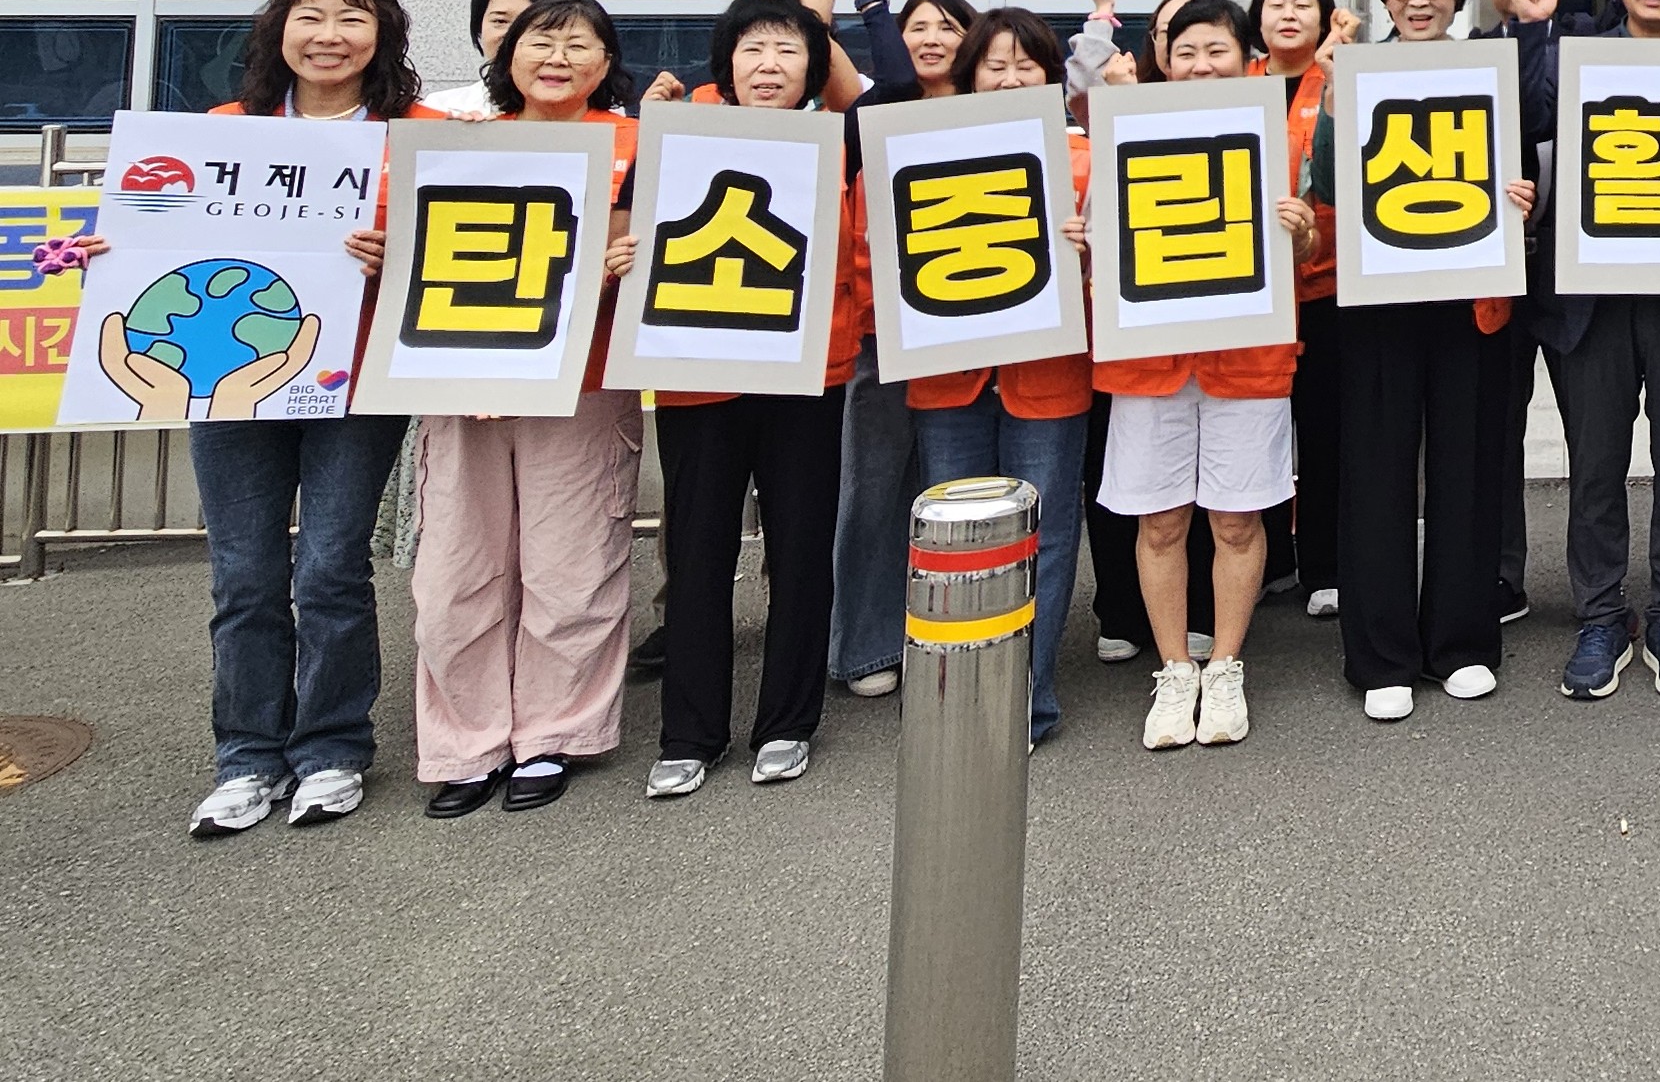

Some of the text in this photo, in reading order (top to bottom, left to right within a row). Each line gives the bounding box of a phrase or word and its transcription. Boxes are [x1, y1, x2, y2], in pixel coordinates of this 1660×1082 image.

[204, 159, 372, 202] 거제시
[206, 201, 362, 220] GEOJE-SI
[1363, 106, 1494, 239] 생
[650, 183, 801, 318] 소
[903, 164, 1043, 305] 중
[1123, 145, 1259, 289] 립
[413, 198, 572, 335] 탄
[286, 405, 336, 415] GEOJE
[289, 395, 338, 405] HEART
[290, 385, 315, 394] BIG
